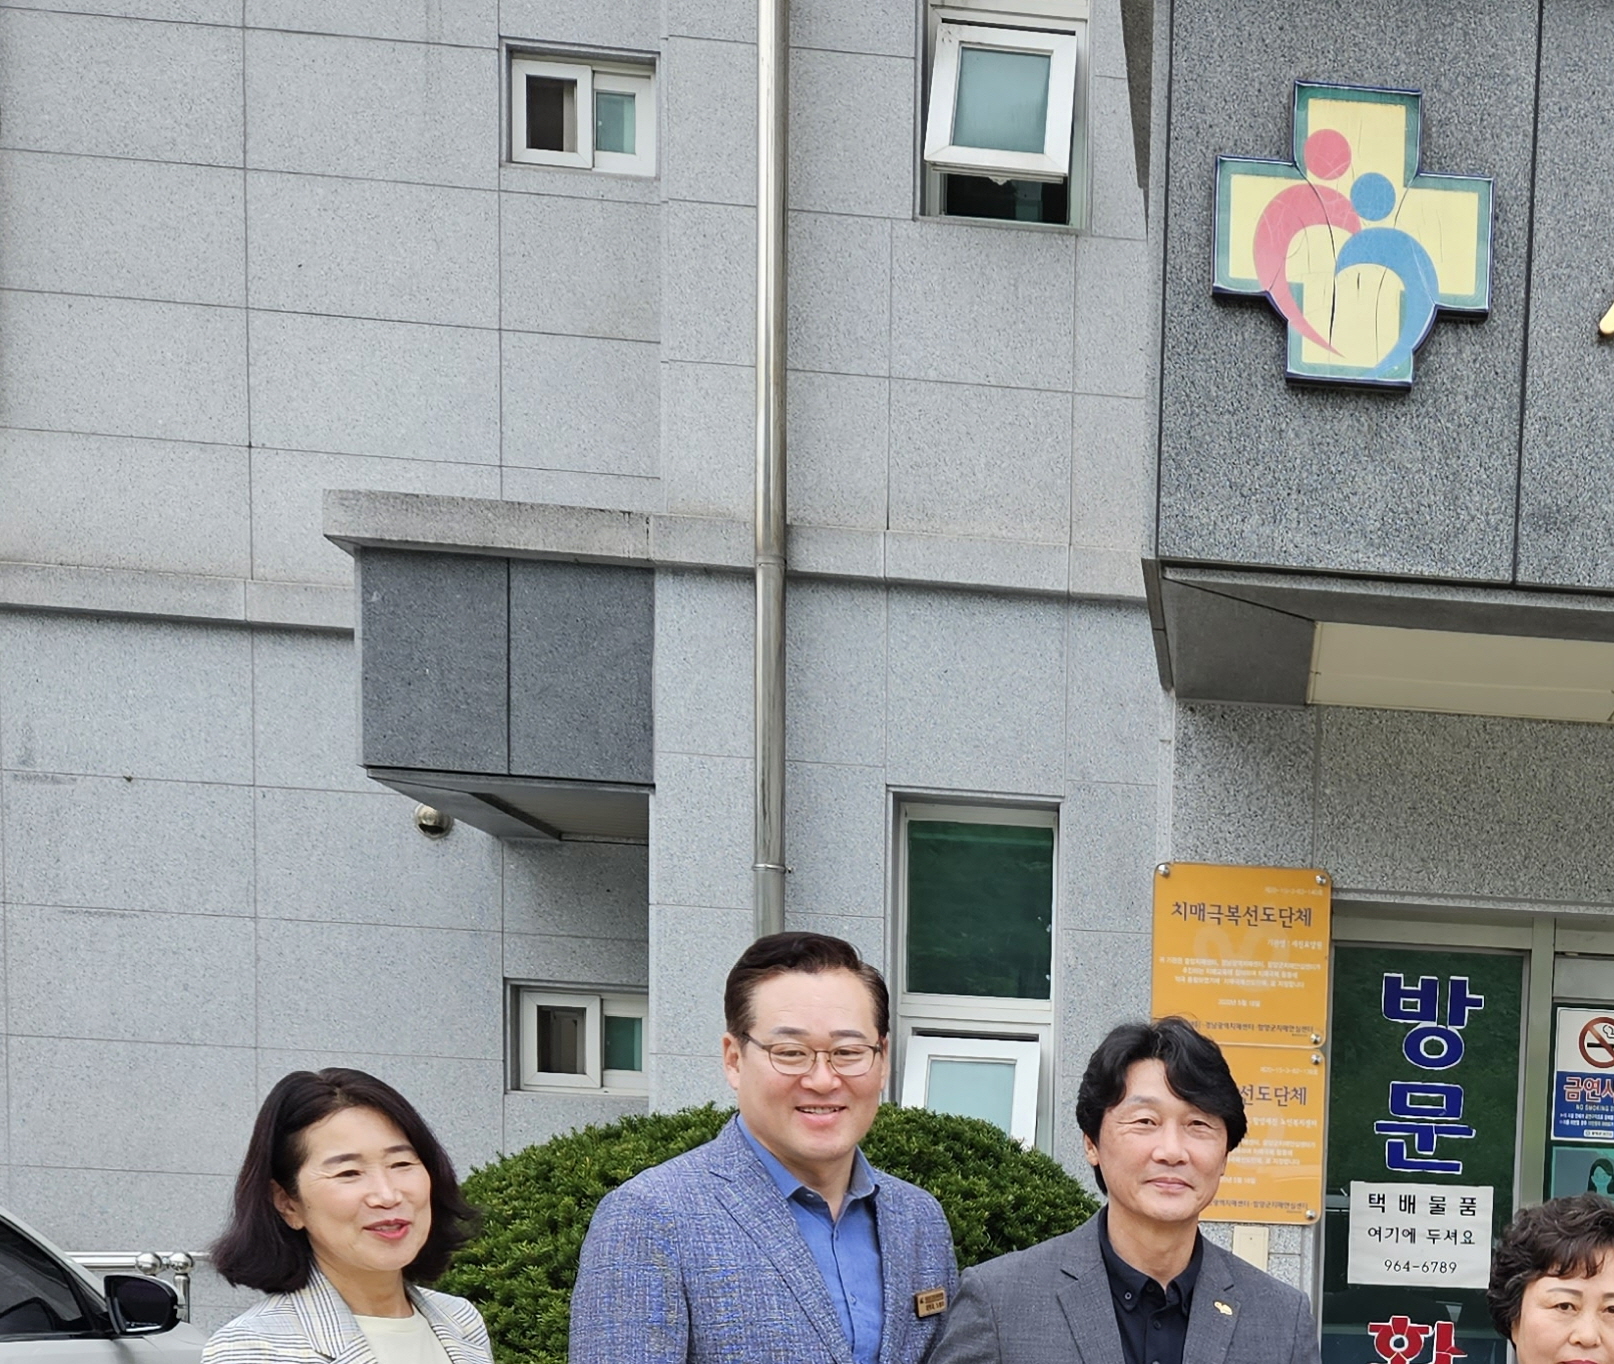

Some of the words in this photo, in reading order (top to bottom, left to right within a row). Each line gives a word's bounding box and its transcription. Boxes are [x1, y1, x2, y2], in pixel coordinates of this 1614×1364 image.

[1171, 901, 1312, 928] 치매극복선도단체
[1368, 1193, 1477, 1217] 택배물품
[1367, 1226, 1416, 1244] 여기에
[1426, 1228, 1476, 1245] 두셔요
[1384, 1259, 1457, 1274] 964-6789
